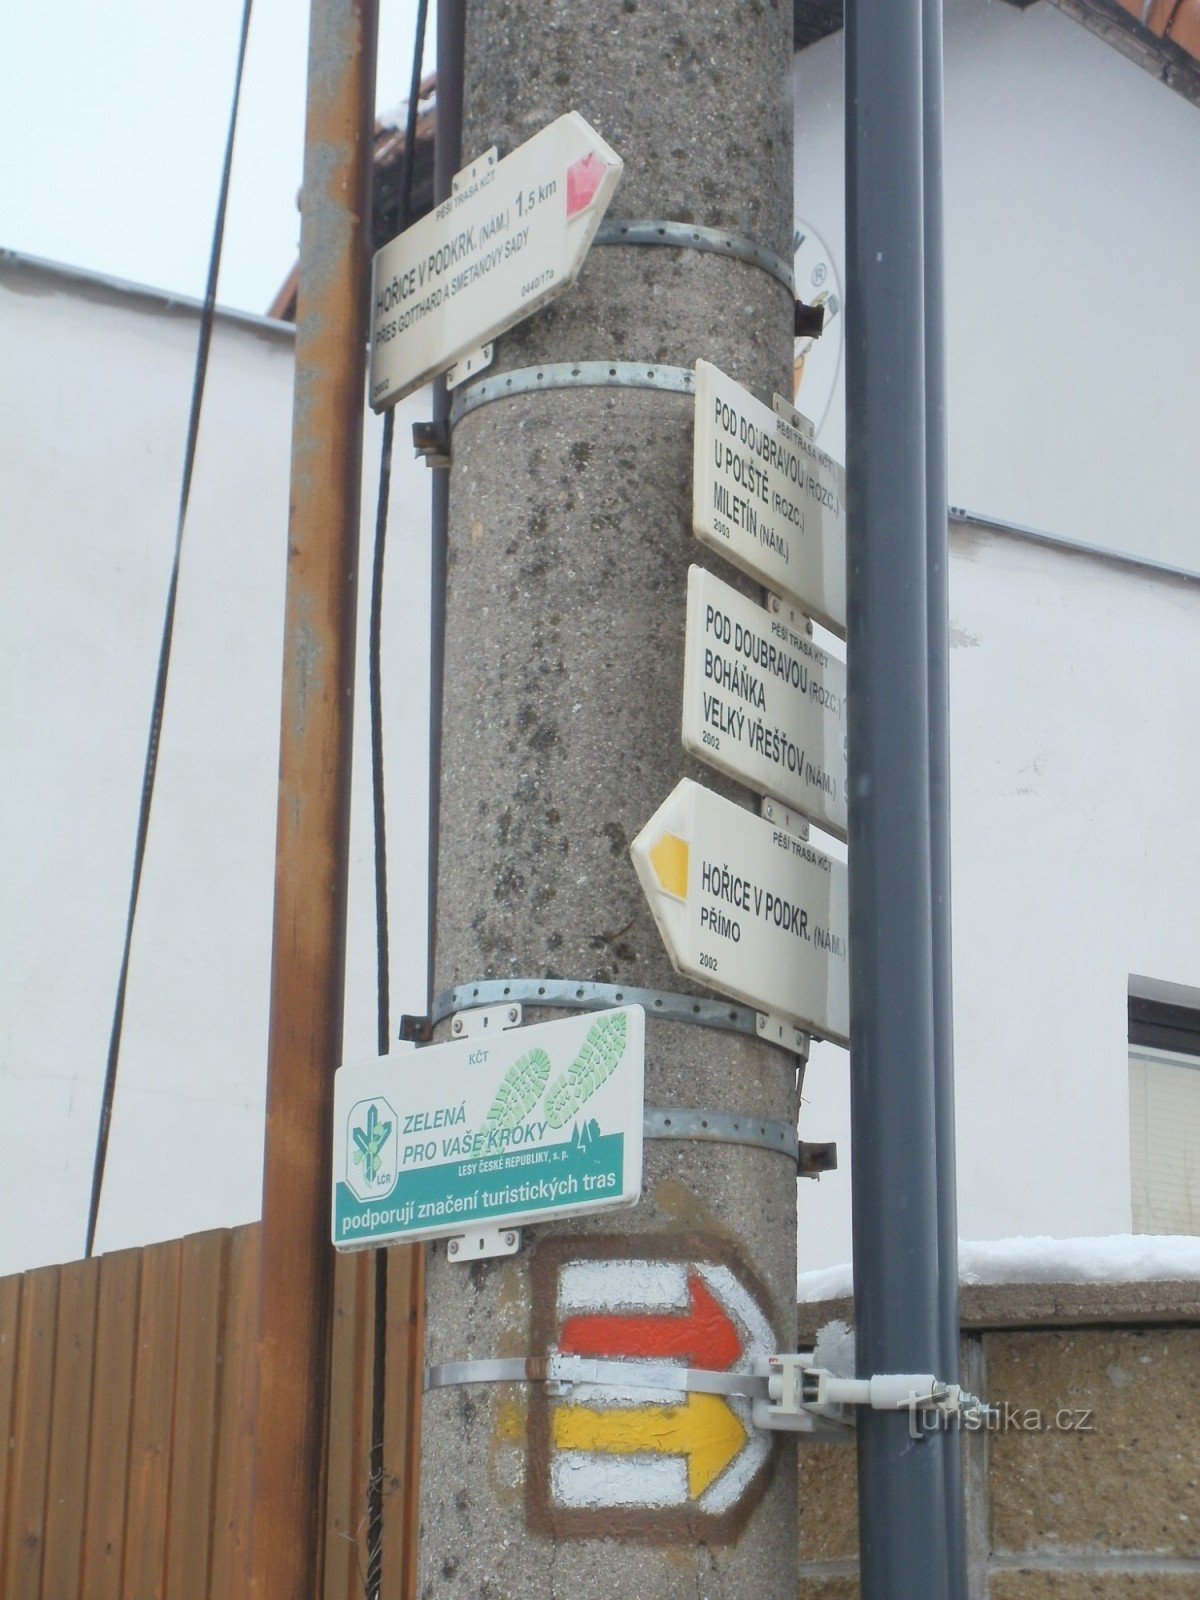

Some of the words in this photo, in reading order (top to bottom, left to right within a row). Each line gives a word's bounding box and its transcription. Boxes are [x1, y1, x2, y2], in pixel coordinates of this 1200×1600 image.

[455, 183, 478, 207] TRASA
[376, 267, 416, 318] HOŘICE
[418, 260, 426, 288] V
[428, 226, 477, 282] PODKRK.
[515, 190, 535, 218] 1,5
[538, 179, 557, 202] km
[375, 319, 397, 346] PŘES
[398, 289, 441, 333] GOTTHARD
[443, 283, 450, 302] A
[504, 226, 529, 259] SADY
[715, 397, 738, 437] POD
[740, 415, 804, 489] DOUBRAVOU
[805, 474, 840, 520] (ROZC.)
[793, 432, 816, 458] TRASA
[714, 439, 723, 469] U
[725, 448, 769, 504] POLŠTĚ
[771, 489, 806, 536] (ROZC.)
[713, 518, 730, 539] 2003
[714, 480, 757, 538] MILETÍN
[759, 523, 790, 565] (NÁM.)
[706, 604, 732, 645] POD
[735, 622, 808, 694] DOUBRAVOU
[809, 680, 842, 720] (ROZC.)
[771, 621, 788, 644] PĚŠÍ
[789, 633, 814, 659] TRASA
[814, 650, 829, 669] KČT
[704, 648, 767, 712] BOHÁŇKA
[702, 730, 720, 750] 2002
[703, 691, 746, 741] VELKÝ
[748, 717, 805, 776] VŘEŠŤOV
[805, 762, 837, 798] (NÁM.)
[773, 832, 790, 851] PĚŠÍ
[791, 842, 817, 866] TRASA
[818, 854, 833, 873] KČT
[700, 906, 741, 943] PŘÍMO
[702, 861, 751, 912] HOŘICE
[754, 886, 763, 917] V
[765, 892, 811, 942] PODKR.
[813, 925, 847, 963] (NÁM.)
[699, 952, 718, 972] 2002
[468, 1049, 490, 1066] KČT
[402, 1100, 467, 1136] ZELENÁ
[402, 1142, 438, 1166] PRO
[441, 1130, 482, 1157] VAŠE
[486, 1120, 549, 1152] KROKY
[458, 1161, 477, 1177] LESY
[478, 1155, 505, 1174] ČESKÉ
[505, 1150, 550, 1170] REPUBLIKY,
[341, 1198, 415, 1235] podporují
[418, 1190, 479, 1219] značení
[482, 1172, 579, 1208] turistických
[583, 1170, 617, 1191] tras
